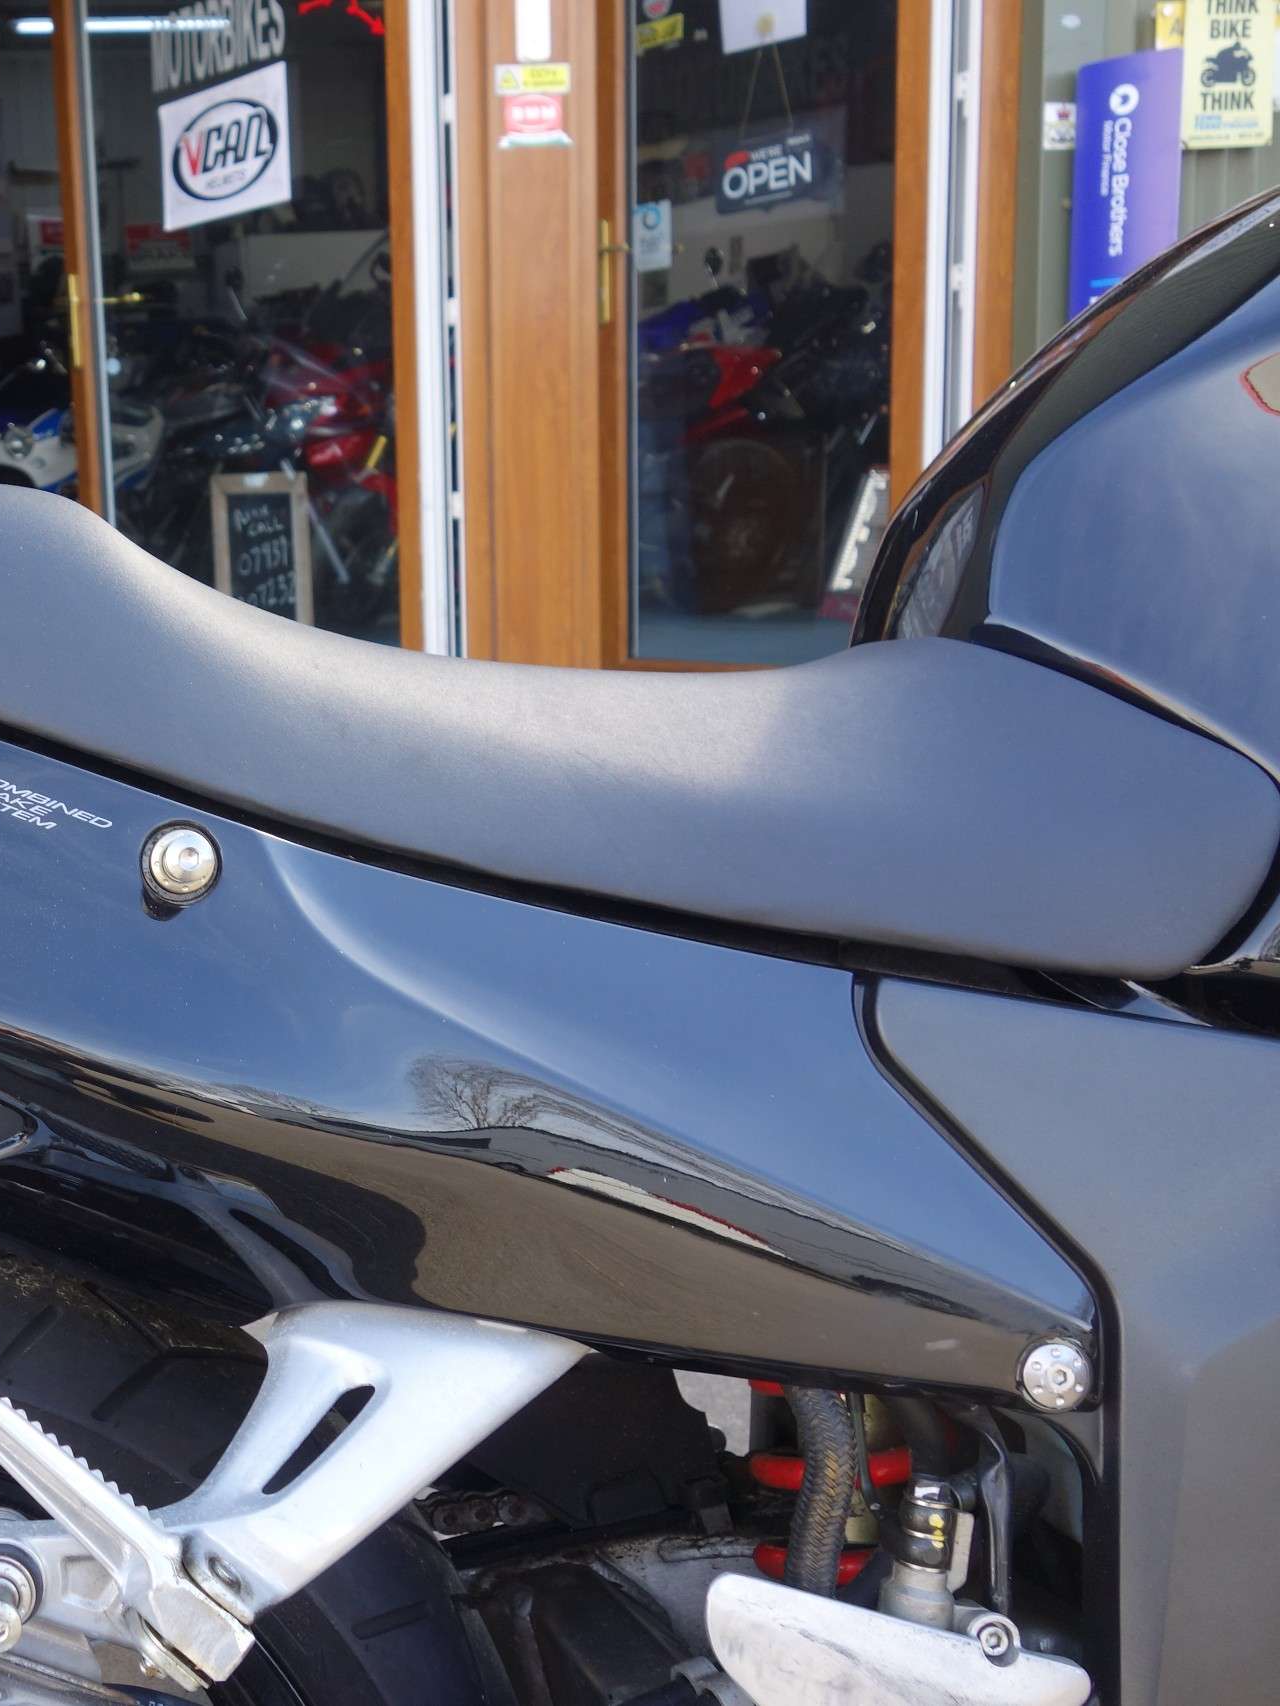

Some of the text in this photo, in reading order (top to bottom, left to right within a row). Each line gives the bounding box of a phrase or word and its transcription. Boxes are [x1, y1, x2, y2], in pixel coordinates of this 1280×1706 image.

[1206, 0, 1259, 14] THINK
[151, 0, 285, 92] MOTORBIKES
[1210, 19, 1251, 39] BIKE
[1201, 91, 1254, 111] THINK
[723, 151, 812, 199] OPEN
[1108, 117, 1132, 257] Close Brothers
